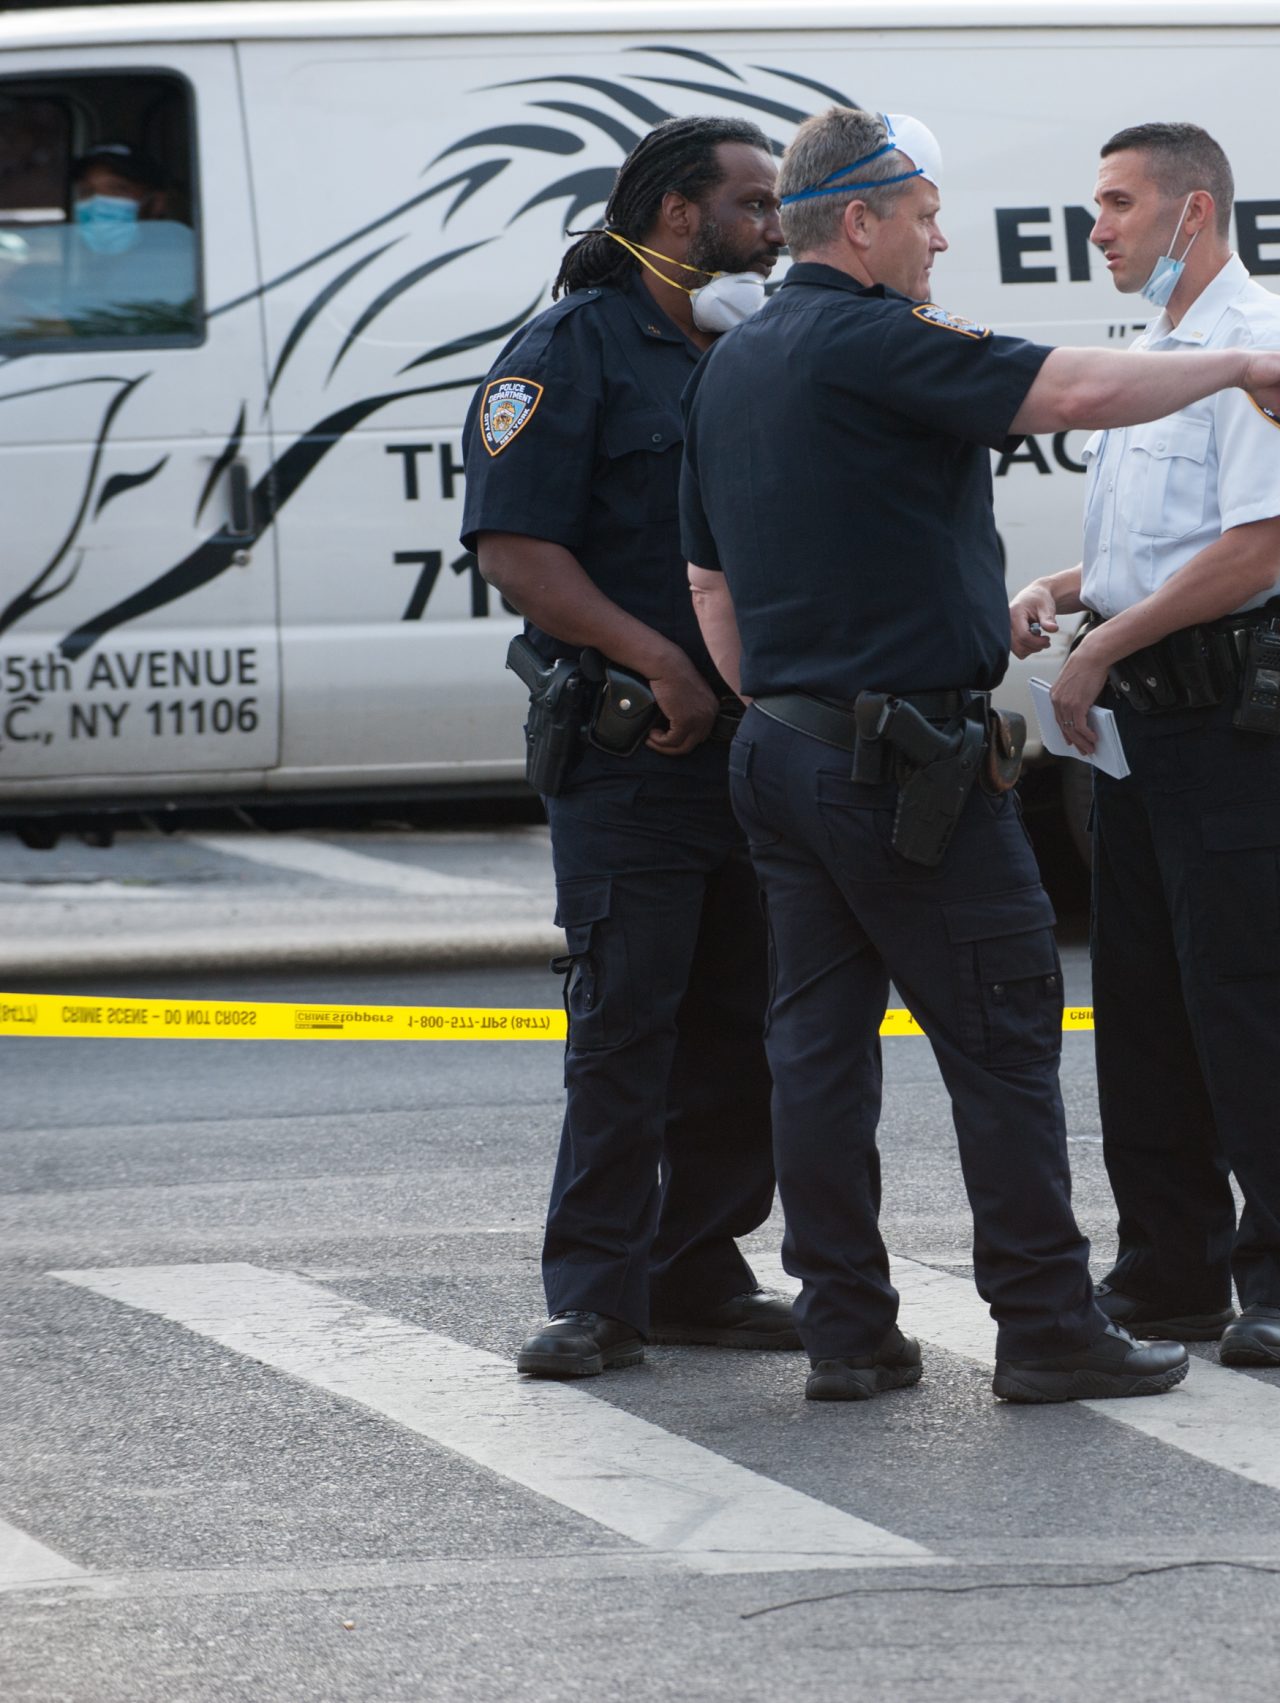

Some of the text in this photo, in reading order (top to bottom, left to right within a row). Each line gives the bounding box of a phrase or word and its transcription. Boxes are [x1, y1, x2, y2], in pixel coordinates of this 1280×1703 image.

[488, 391, 533, 404] DEPARTMENT
[499, 383, 526, 393] POLICE
[500, 408, 530, 445] NEW YORK
[0, 648, 259, 693] 5th AVENUE
[69, 702, 129, 740] NY
[146, 697, 259, 736] 11106
